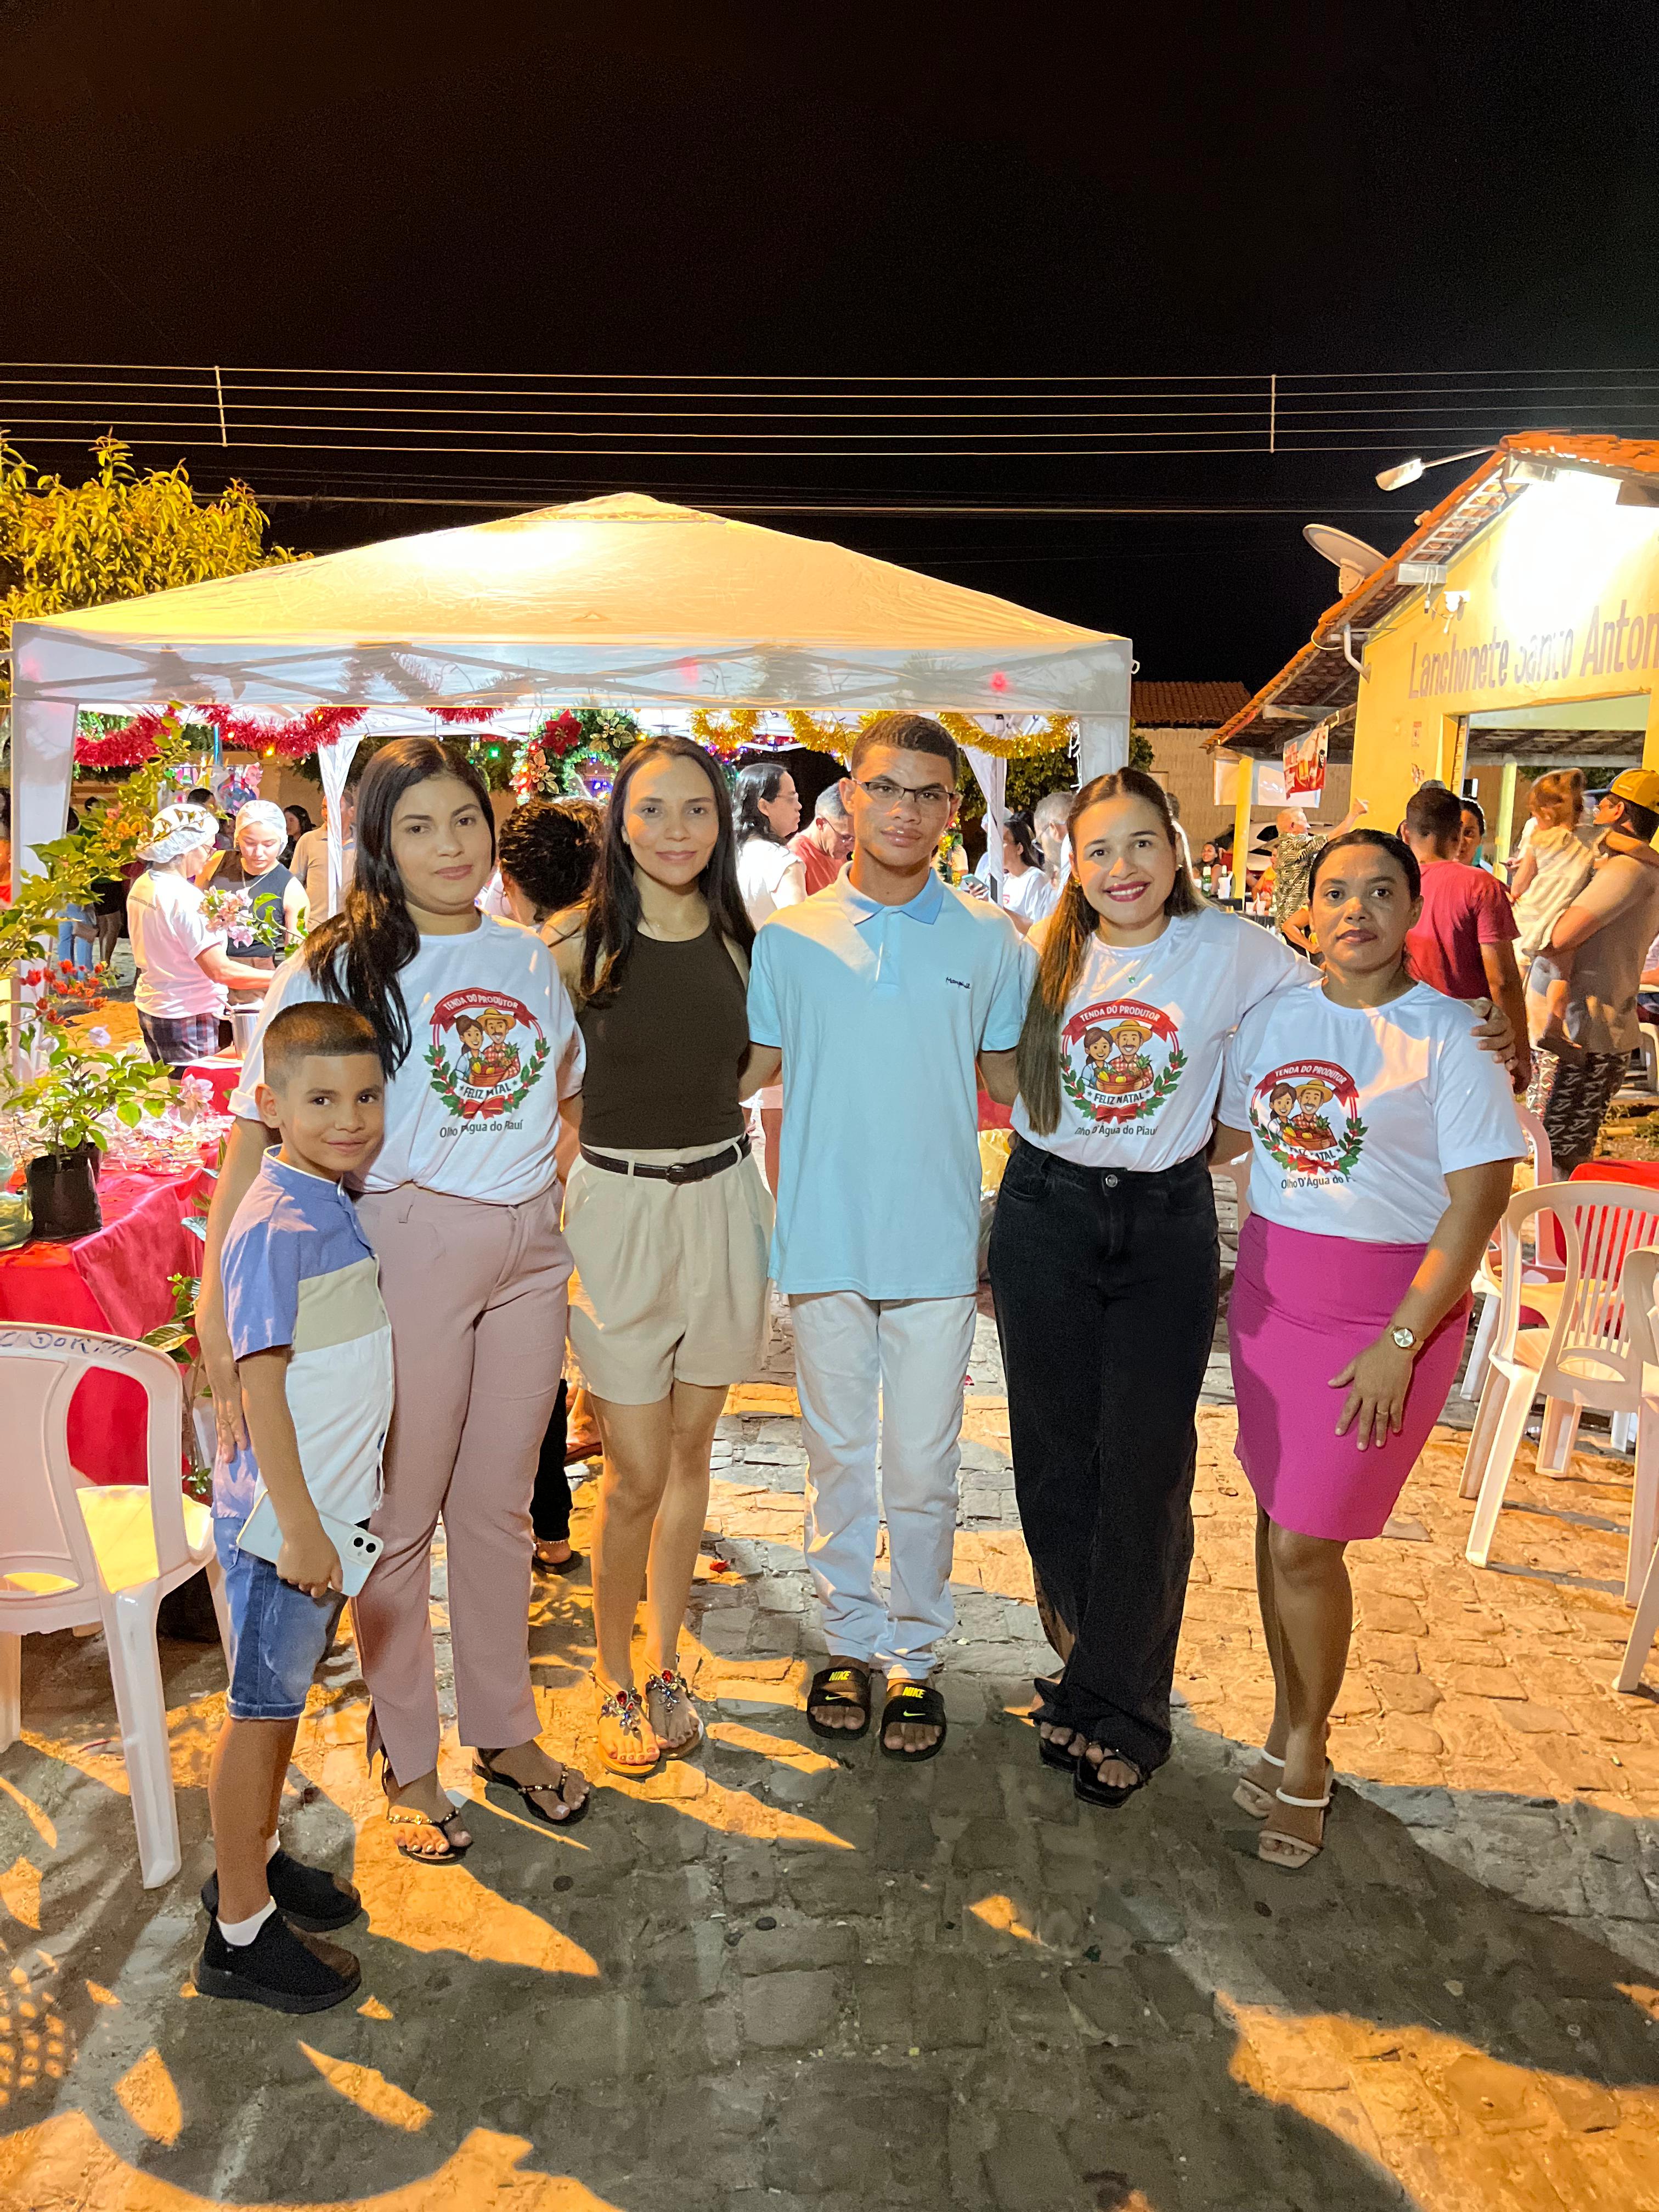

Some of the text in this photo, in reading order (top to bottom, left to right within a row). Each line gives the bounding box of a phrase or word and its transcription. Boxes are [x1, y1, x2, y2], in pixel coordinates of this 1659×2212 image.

[1408, 627, 1509, 699] Lanchonete
[443, 994, 518, 1011] TENDA DO PRODUTOR
[1079, 1005, 1160, 1022] TENDA DO PRODUTOR
[1275, 1065, 1347, 1085] TENDA DO PRODUTOR
[486, 1082, 511, 1097] NTAL
[1094, 1092, 1144, 1104] FELIZ NATAL
[490, 1121, 502, 1131] do
[1122, 1125, 1134, 1135] do
[1281, 1178, 1297, 1189] Olho
[1333, 1175, 1344, 1184] do
[828, 1671, 851, 1681] NIKE
[902, 1687, 926, 1699] NIKE
